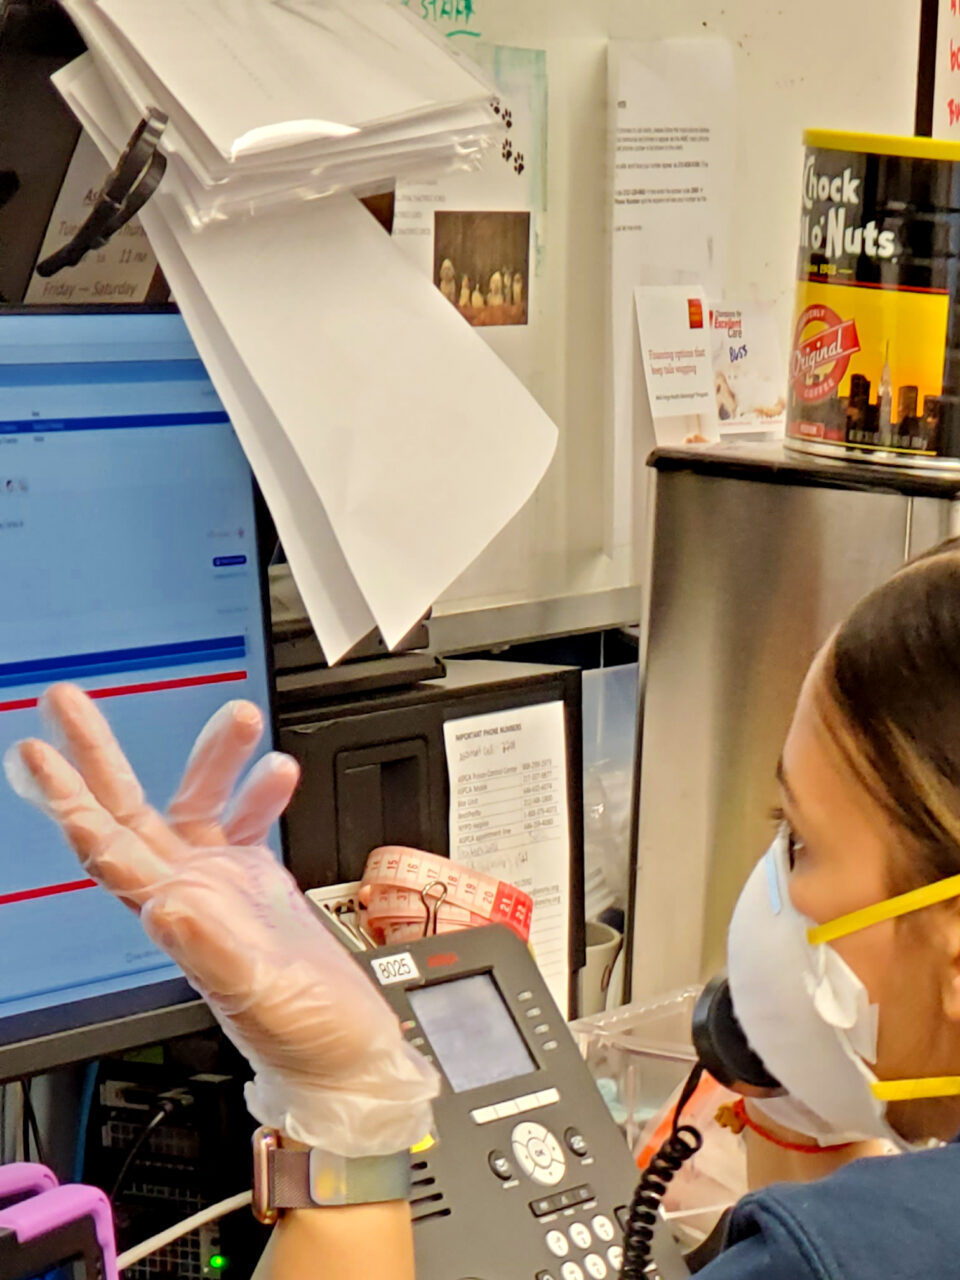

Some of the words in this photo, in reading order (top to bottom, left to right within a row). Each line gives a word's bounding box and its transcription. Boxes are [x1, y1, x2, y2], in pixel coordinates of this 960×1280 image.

[802, 155, 861, 210] Chock
[43, 281, 77, 298] Friday
[91, 280, 139, 298] Saturday
[714, 316, 742, 329] Excellent
[727, 327, 742, 339] Care
[789, 326, 844, 377] Original
[455, 729, 482, 742] IMPORTANT
[483, 726, 499, 737] PHONE
[386, 858, 399, 871] 15
[406, 862, 419, 875] 16
[426, 867, 439, 880] 17
[447, 875, 458, 889] 18
[464, 882, 477, 896] 19
[482, 889, 495, 906] 20
[499, 897, 512, 913] 21
[514, 906, 527, 923] 22
[378, 957, 412, 981] 8025
